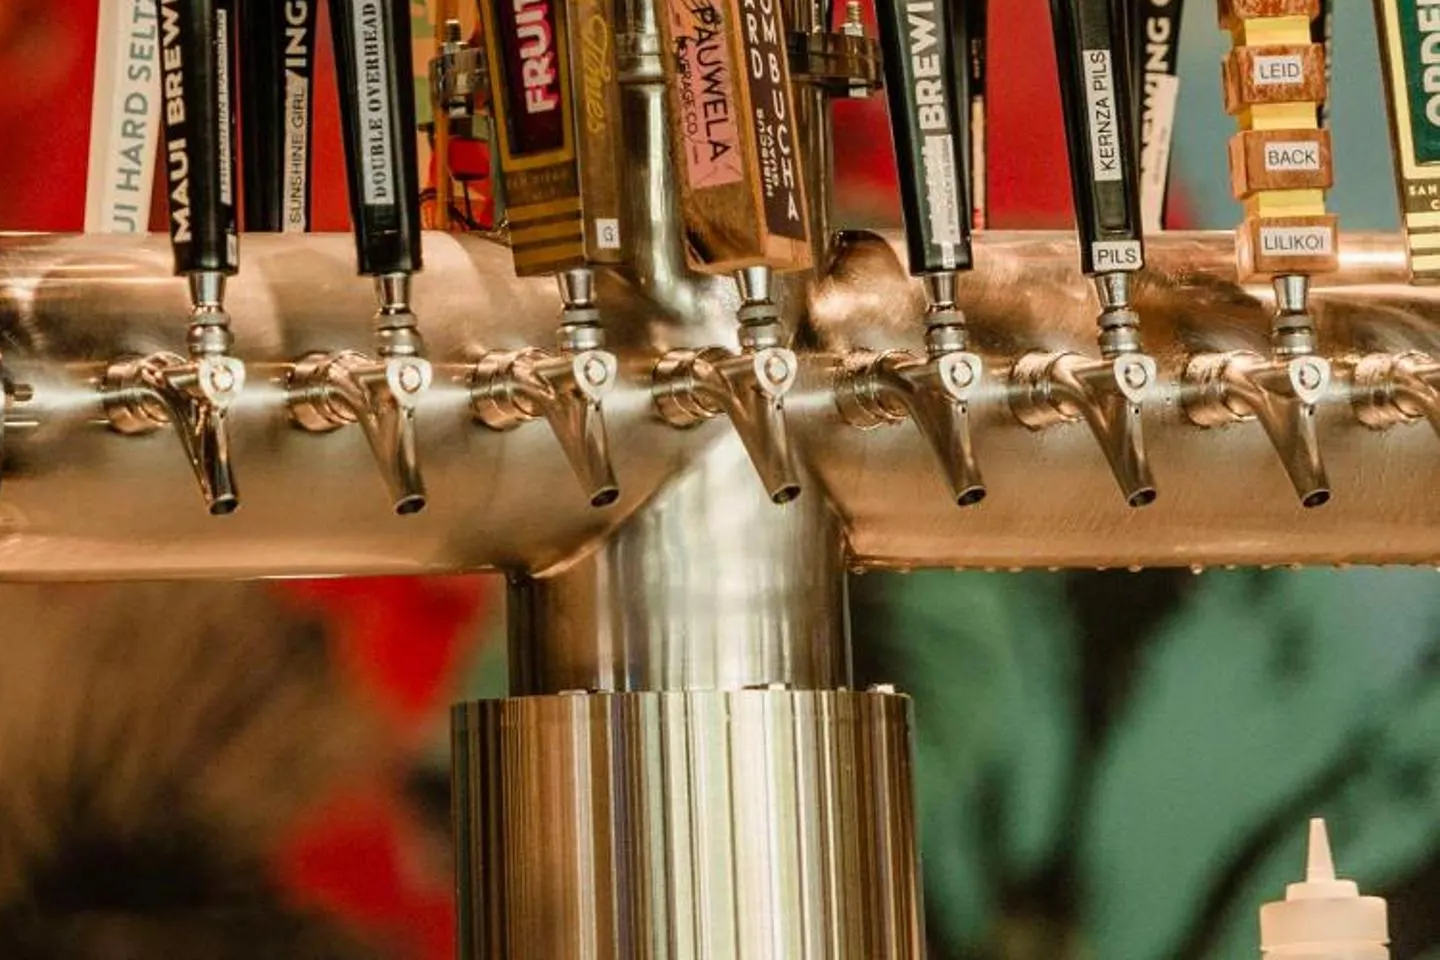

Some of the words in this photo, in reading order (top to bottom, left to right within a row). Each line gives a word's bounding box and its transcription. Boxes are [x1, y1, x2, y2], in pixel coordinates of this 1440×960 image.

[362, 1, 383, 113] OVERHEAD
[691, 4, 732, 162] PAUWELA
[1090, 50, 1110, 93] PILS
[1259, 62, 1300, 80] LEID
[116, 91, 149, 192] HARD
[291, 90, 305, 133] GIRL
[1093, 97, 1116, 171] KERNZA
[168, 138, 193, 243] MAUI
[289, 134, 304, 224] SUNSHINE
[368, 117, 388, 200] DOUBLE
[1268, 148, 1317, 167] BACK
[1096, 247, 1138, 265] PILS
[1264, 234, 1325, 251] LILIKOI
